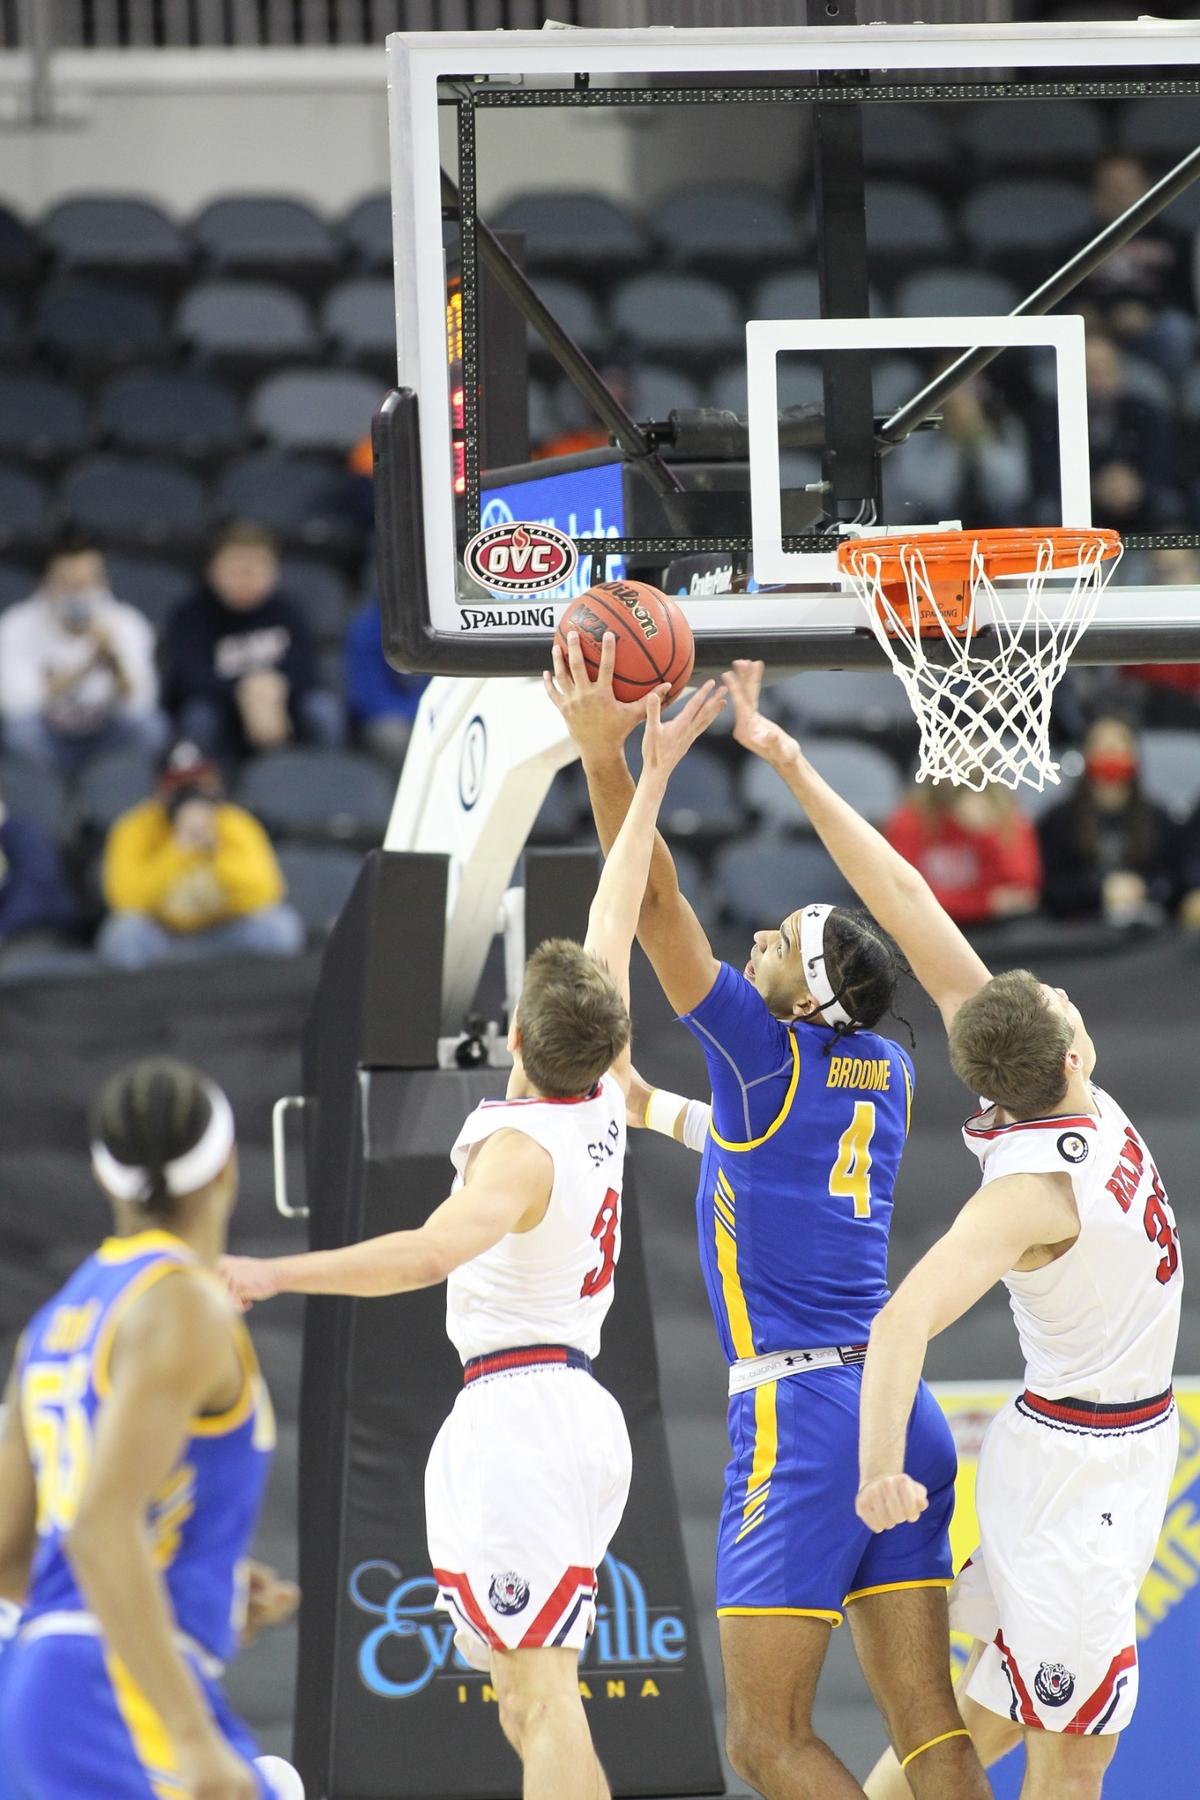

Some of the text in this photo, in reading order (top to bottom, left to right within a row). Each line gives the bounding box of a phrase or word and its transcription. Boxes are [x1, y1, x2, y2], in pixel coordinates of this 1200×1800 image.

[477, 529, 571, 551] OHIO VALLEY
[488, 545, 552, 573] OVC
[482, 573, 561, 589] CONFERENCE
[460, 606, 554, 631] SPALDING
[599, 581, 658, 641] Wilson
[826, 1056, 891, 1091] BROOME
[829, 1101, 875, 1218] 4
[580, 1186, 619, 1299] 3
[458, 1679, 660, 1703] INANA
